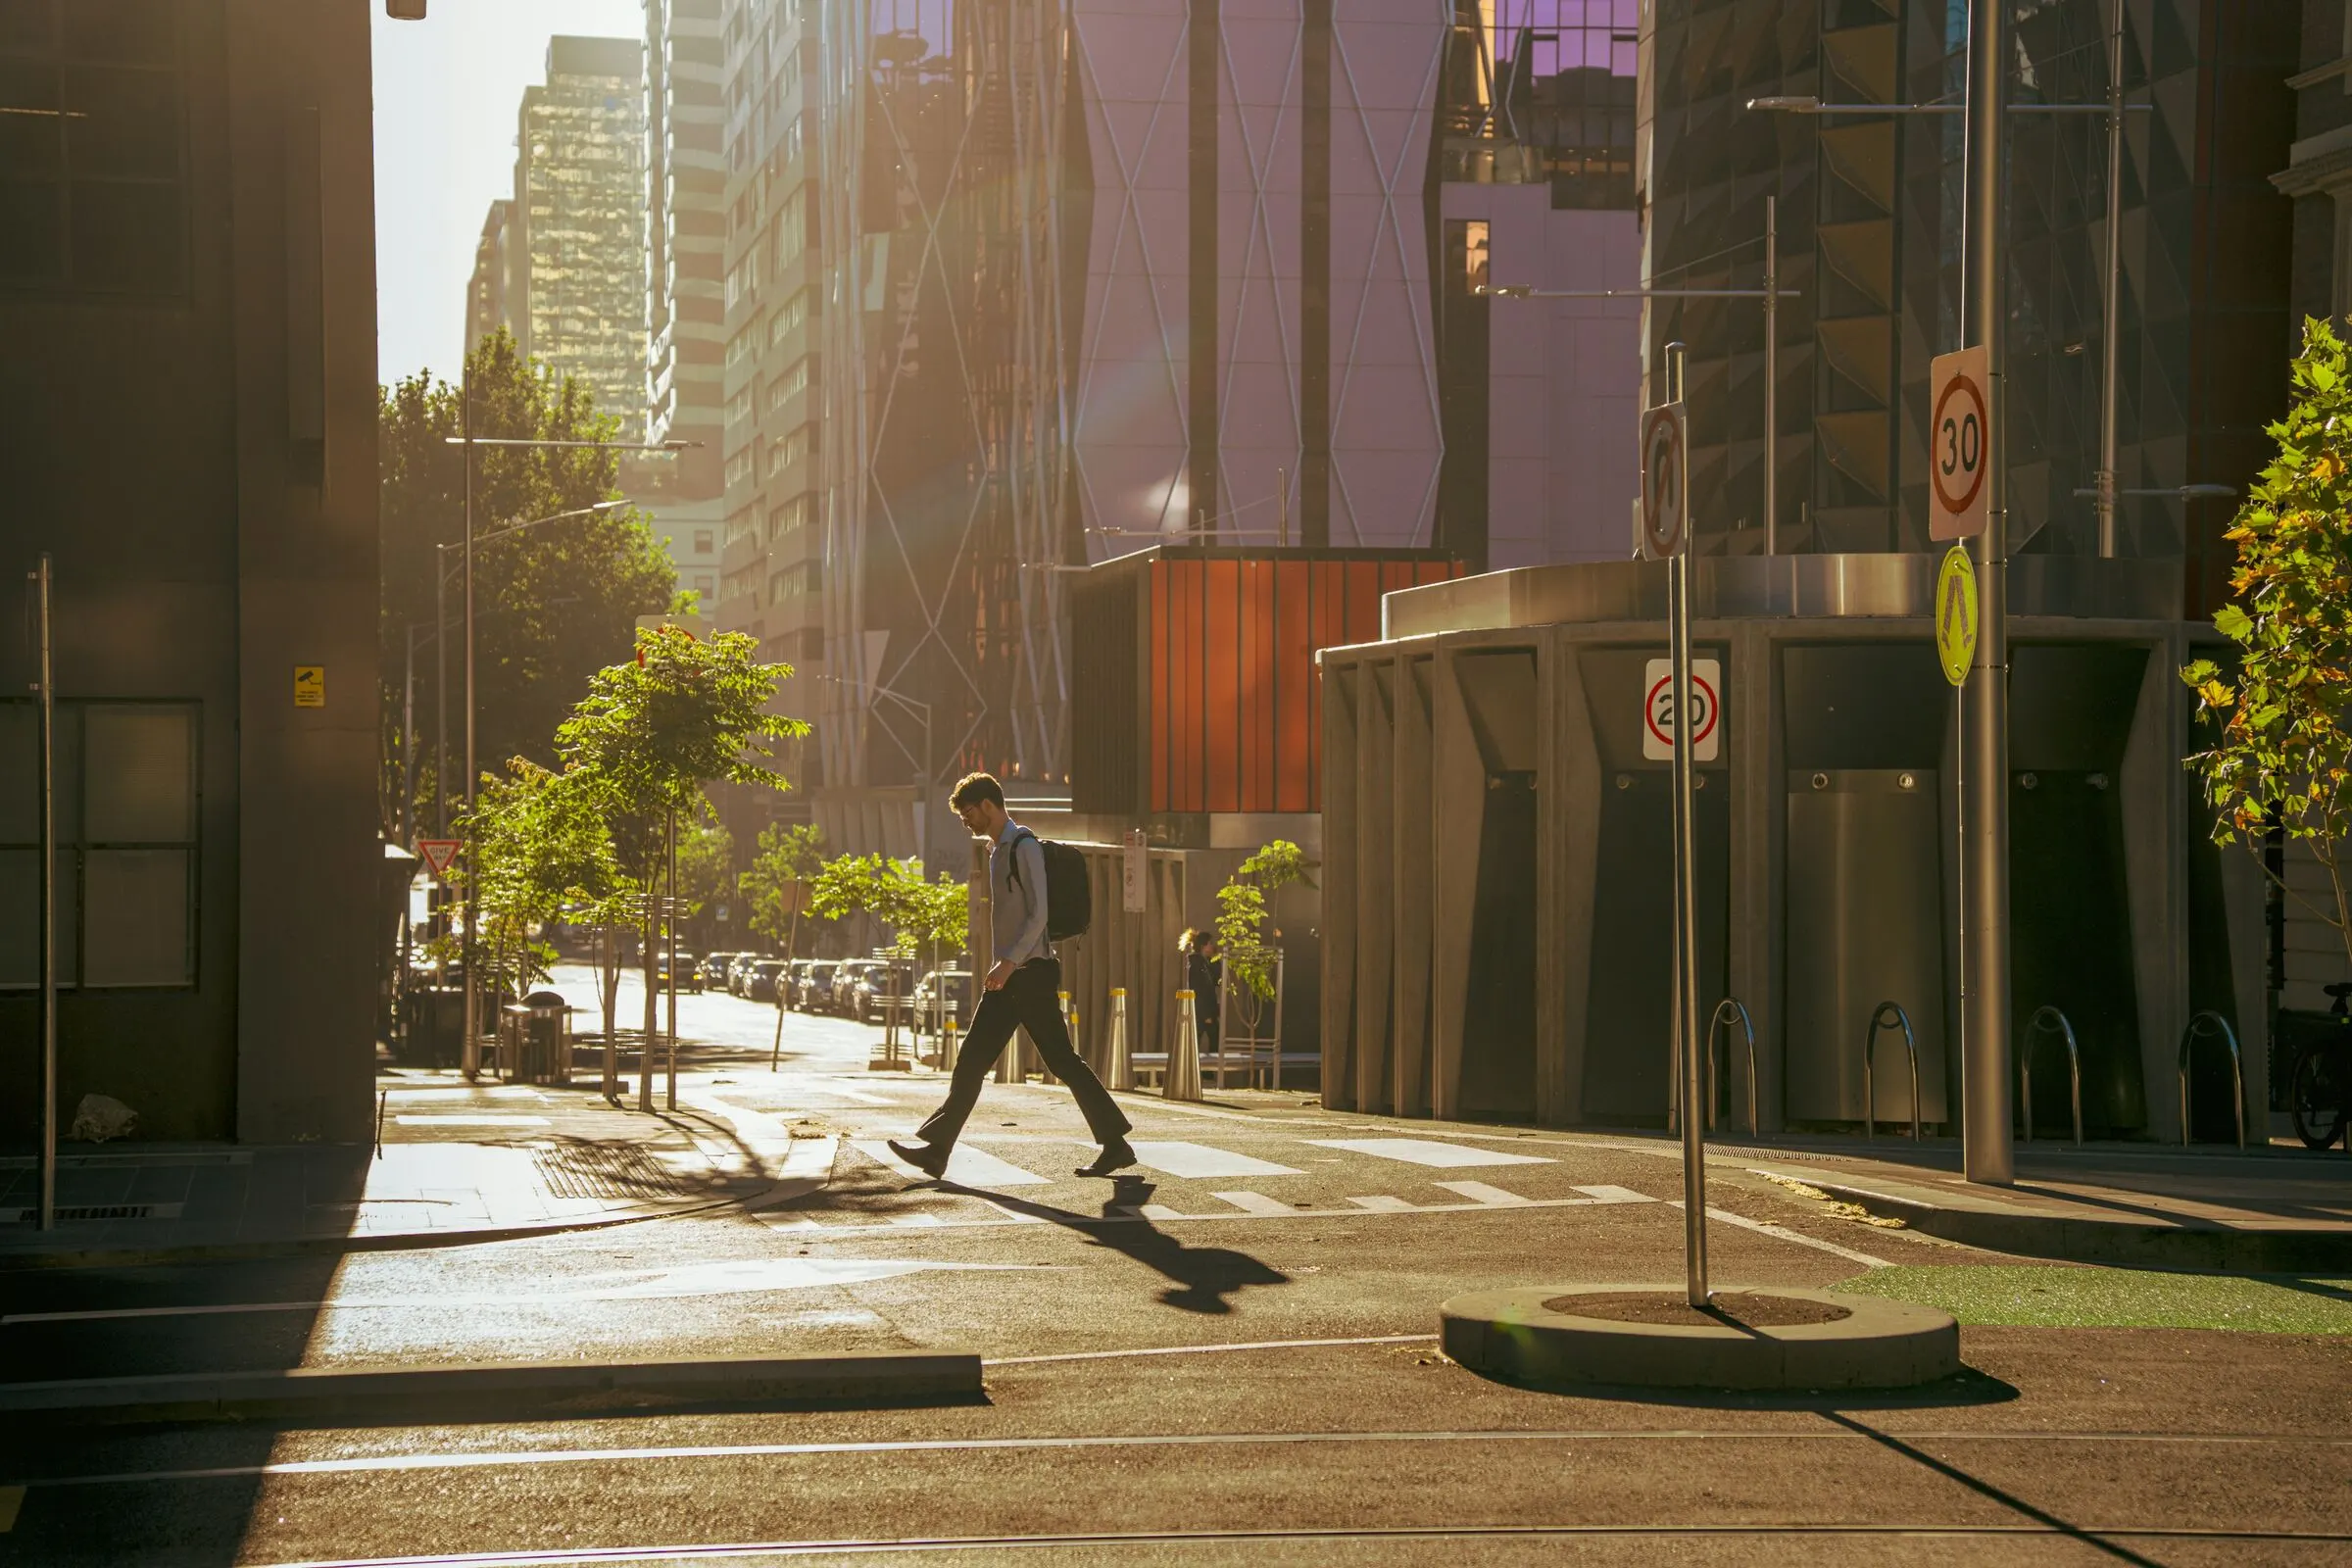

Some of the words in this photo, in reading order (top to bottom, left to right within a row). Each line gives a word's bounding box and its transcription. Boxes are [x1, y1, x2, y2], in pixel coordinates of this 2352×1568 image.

[1941, 413, 1979, 476] 30
[1657, 694, 1705, 726] 20
[429, 846, 450, 855] GIVE
